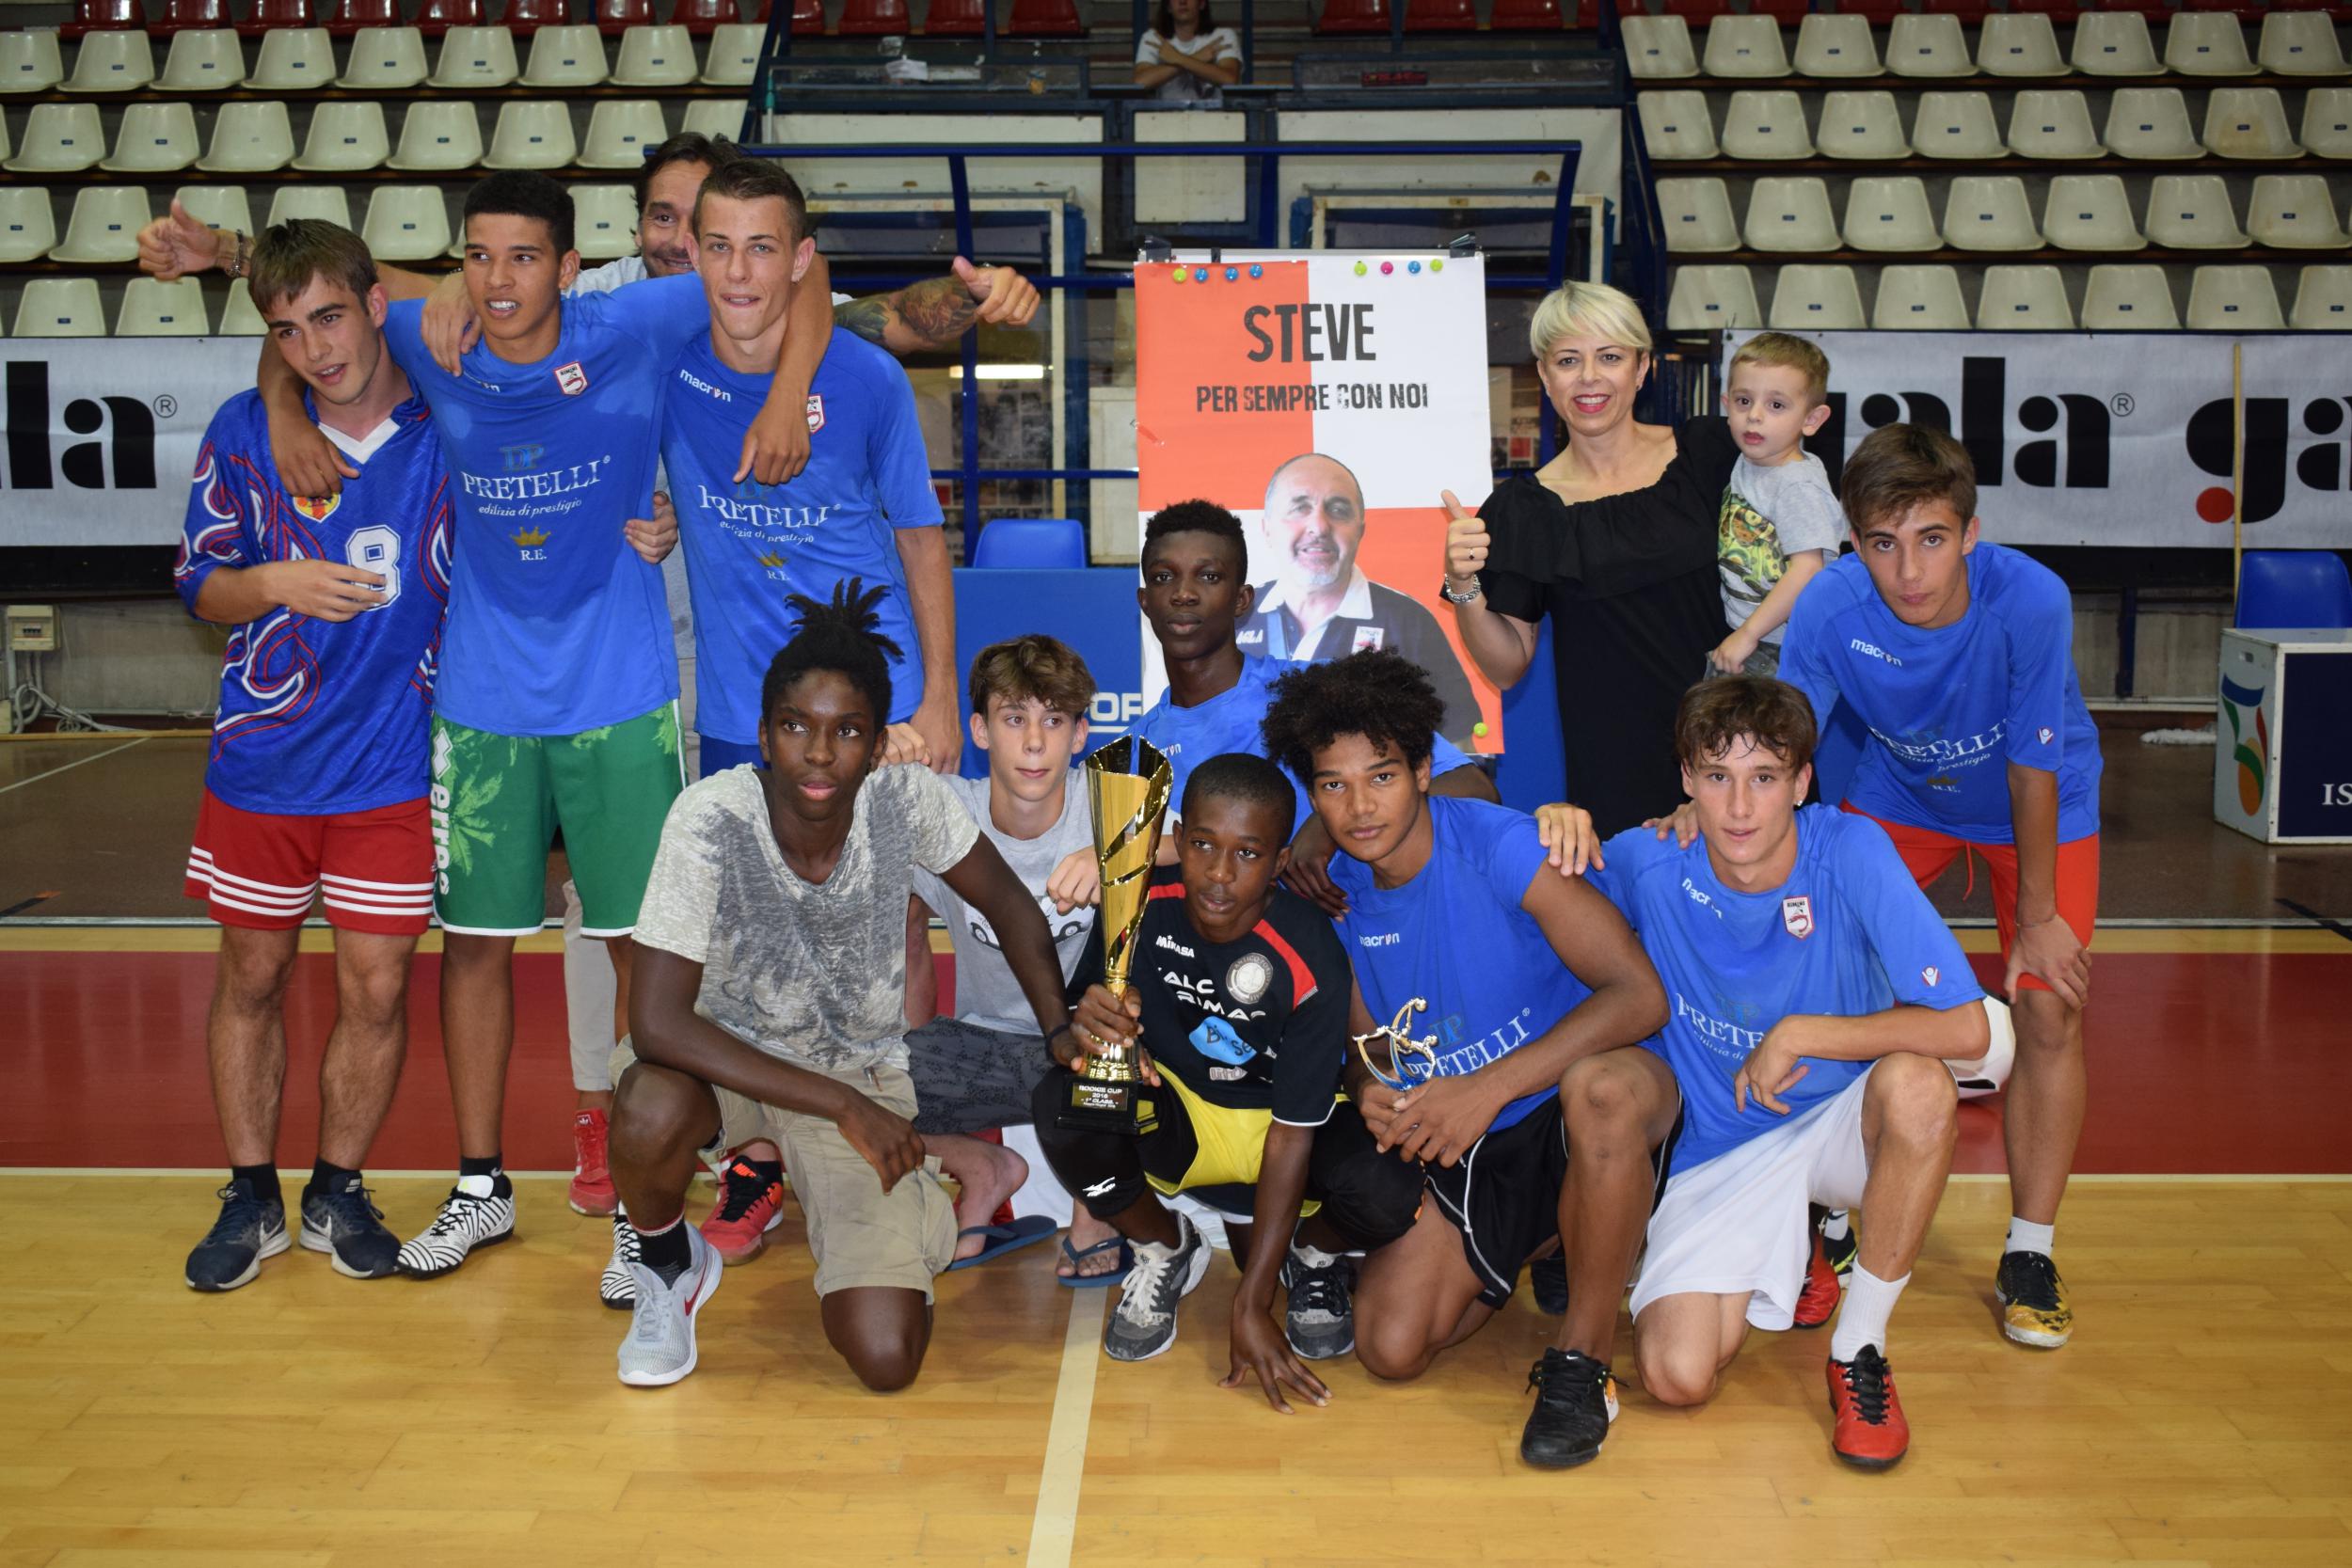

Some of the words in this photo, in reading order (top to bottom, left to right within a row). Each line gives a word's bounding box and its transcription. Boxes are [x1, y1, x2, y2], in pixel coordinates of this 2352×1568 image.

[1244, 303, 1376, 362] STEVE
[679, 369, 731, 403] macron
[1196, 386, 1238, 412] PER
[1243, 384, 1330, 411] SEMPRE
[1337, 383, 1382, 409] CON
[1390, 383, 1428, 408] NOI
[478, 503, 516, 516] edilizia
[518, 502, 529, 516] di
[531, 499, 582, 518] prestigio
[345, 525, 402, 611] 8
